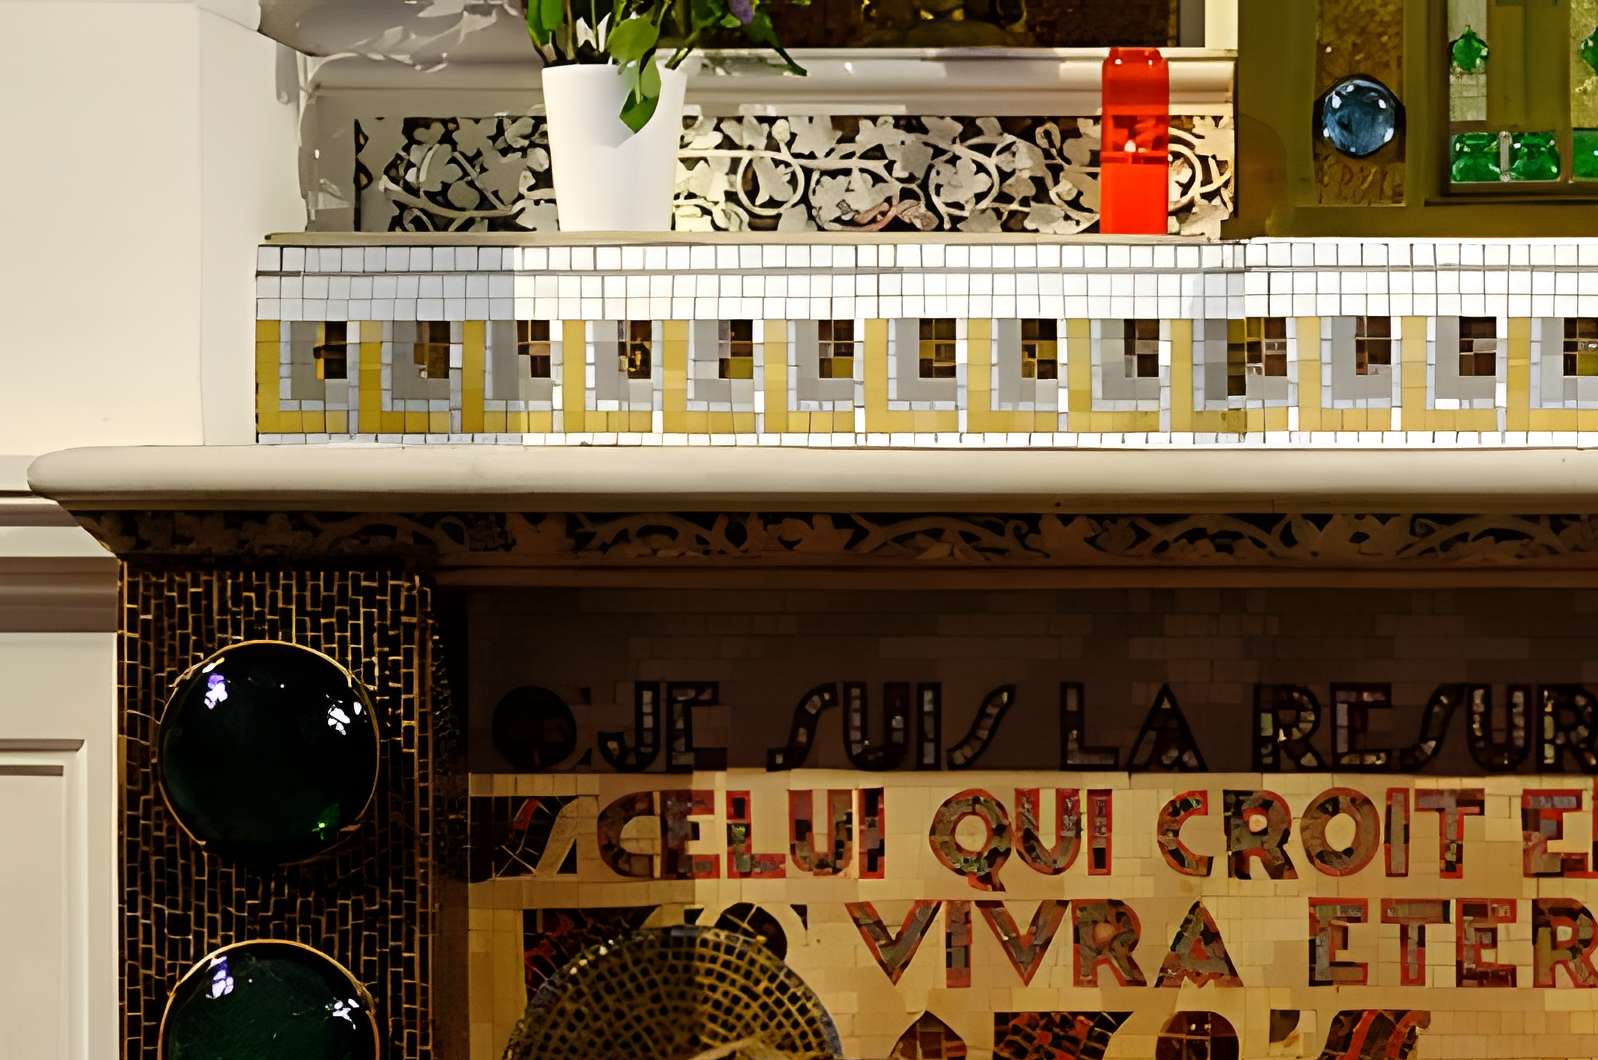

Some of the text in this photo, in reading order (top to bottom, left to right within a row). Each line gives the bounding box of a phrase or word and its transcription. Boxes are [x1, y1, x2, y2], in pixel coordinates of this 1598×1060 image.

[598, 681, 727, 770] JE
[768, 682, 1015, 771] SUIS
[1060, 682, 1206, 771] LA
[599, 787, 885, 879] CELUI
[929, 787, 1112, 892] QUI
[1157, 787, 1485, 880] CROIT
[845, 899, 1244, 987] VIVRA
